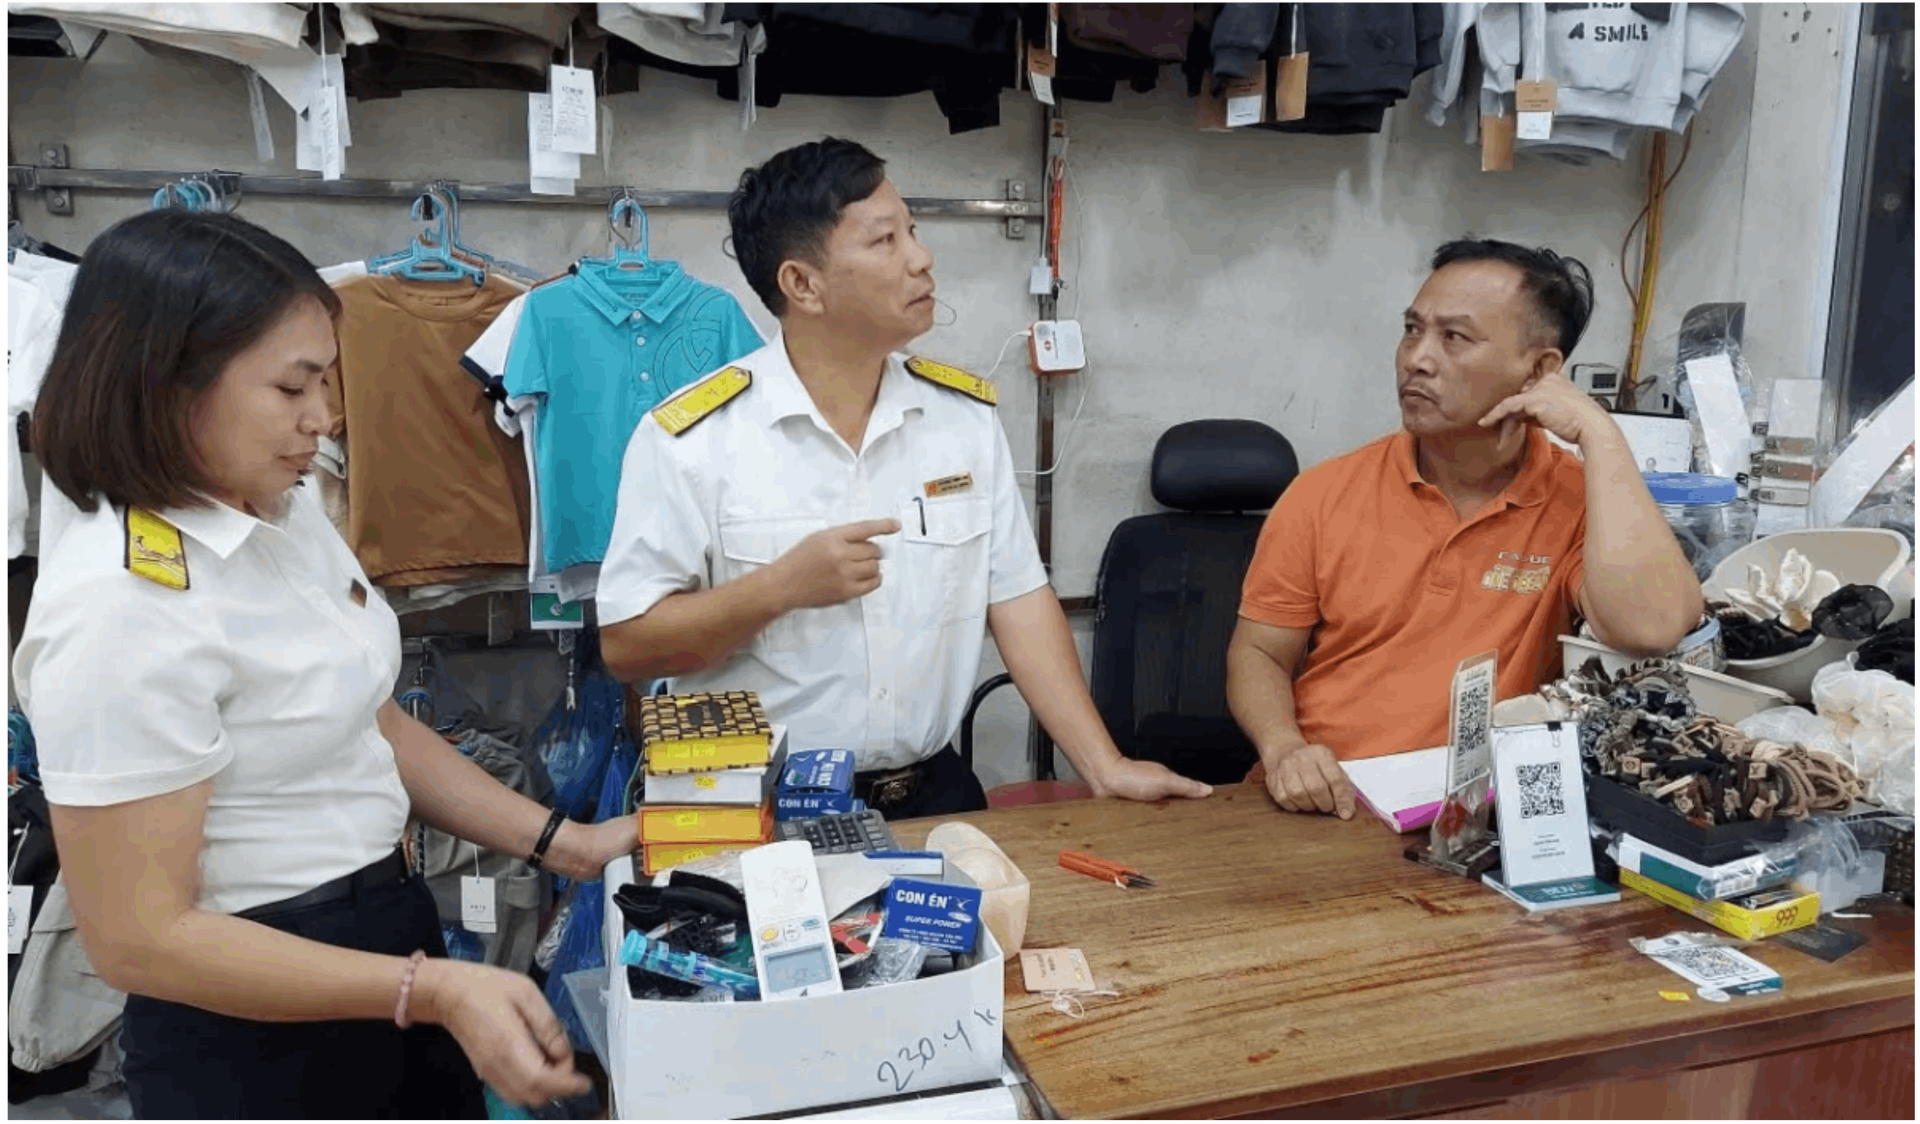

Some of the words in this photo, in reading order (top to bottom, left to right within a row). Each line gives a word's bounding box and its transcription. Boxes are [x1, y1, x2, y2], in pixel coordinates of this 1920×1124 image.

[1568, 21, 1585, 39] A
[1594, 22, 1649, 42] SMILE
[778, 798, 802, 808] CON
[896, 889, 926, 906] CON
[928, 892, 948, 909] ÉN
[904, 914, 932, 924] SUPER
[932, 920, 962, 929] POWER
